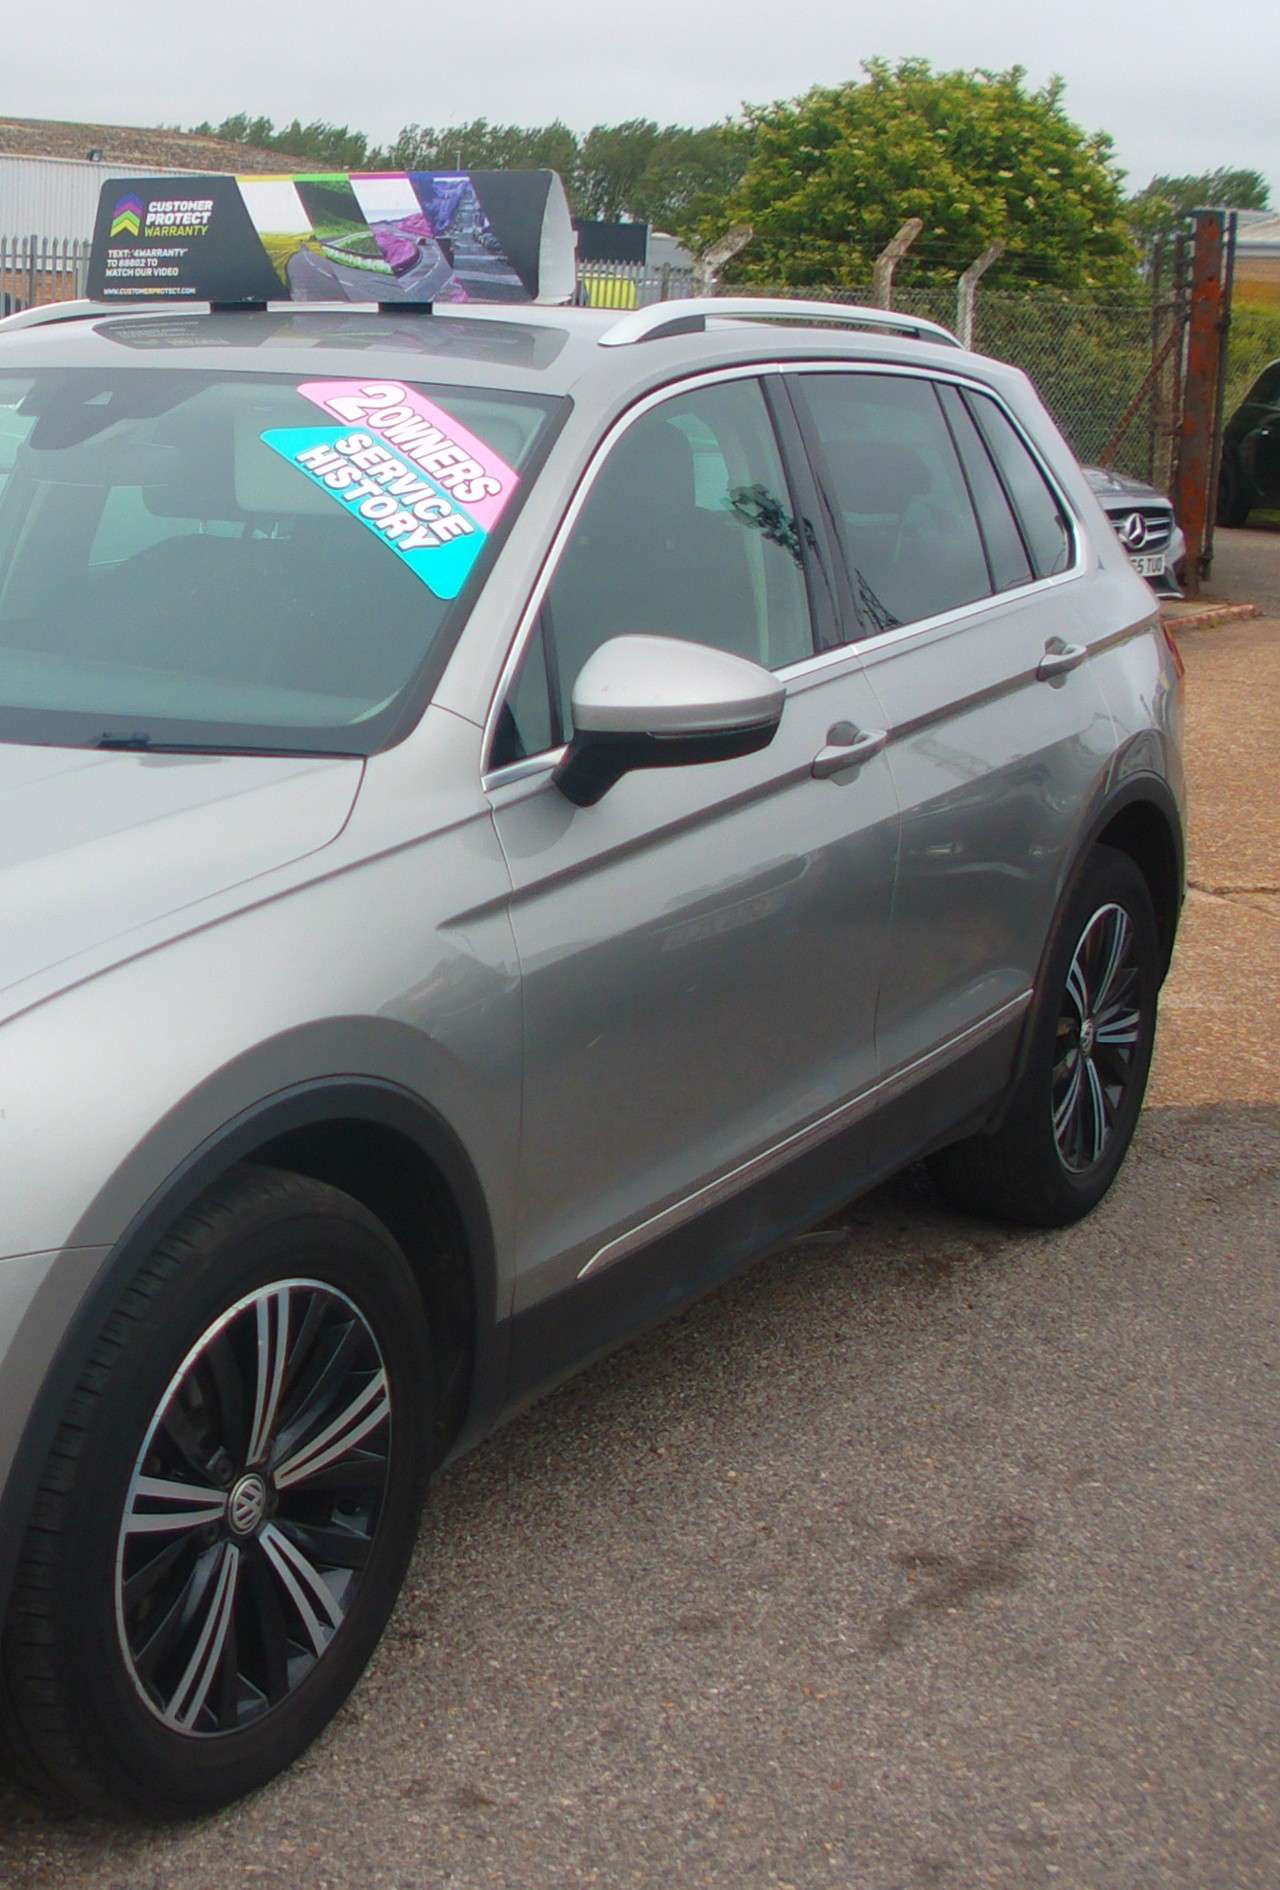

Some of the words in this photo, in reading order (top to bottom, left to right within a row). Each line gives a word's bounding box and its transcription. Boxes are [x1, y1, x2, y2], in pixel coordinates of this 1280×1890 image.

[148, 200, 214, 212] CUSTOMER
[145, 212, 211, 225] PROTECT
[144, 225, 209, 237] WARRANTY
[147, 258, 158, 267] TO
[105, 268, 134, 277] WATCH
[134, 268, 152, 277] OUR
[153, 267, 179, 277] VIDEO
[323, 383, 408, 423] 2
[365, 404, 503, 504] OWNERS
[334, 432, 476, 543] SERVICE
[294, 443, 443, 552] HISTORY
